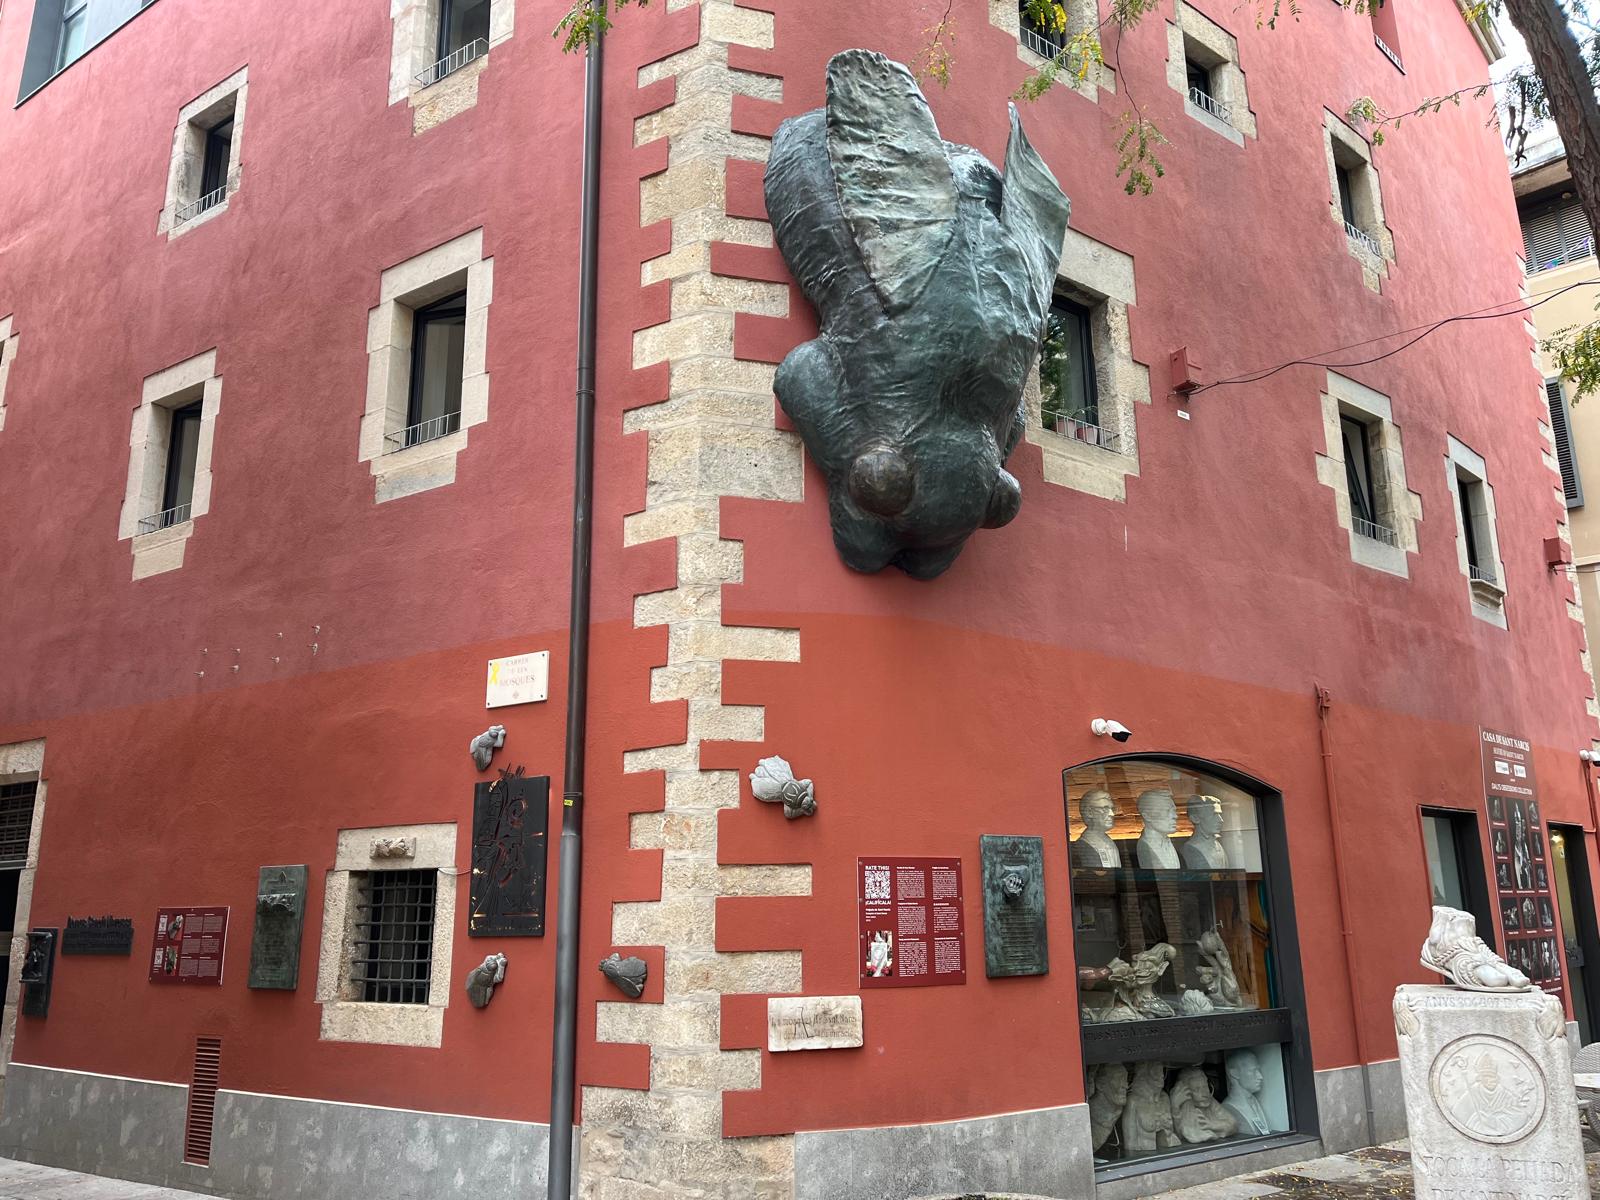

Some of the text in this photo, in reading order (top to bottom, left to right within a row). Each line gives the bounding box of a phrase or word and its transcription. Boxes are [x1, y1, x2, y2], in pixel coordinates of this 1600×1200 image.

[499, 674, 536, 686] MOSQUES
[1482, 731, 1496, 743] CASA
[1501, 736, 1514, 748] SANT
